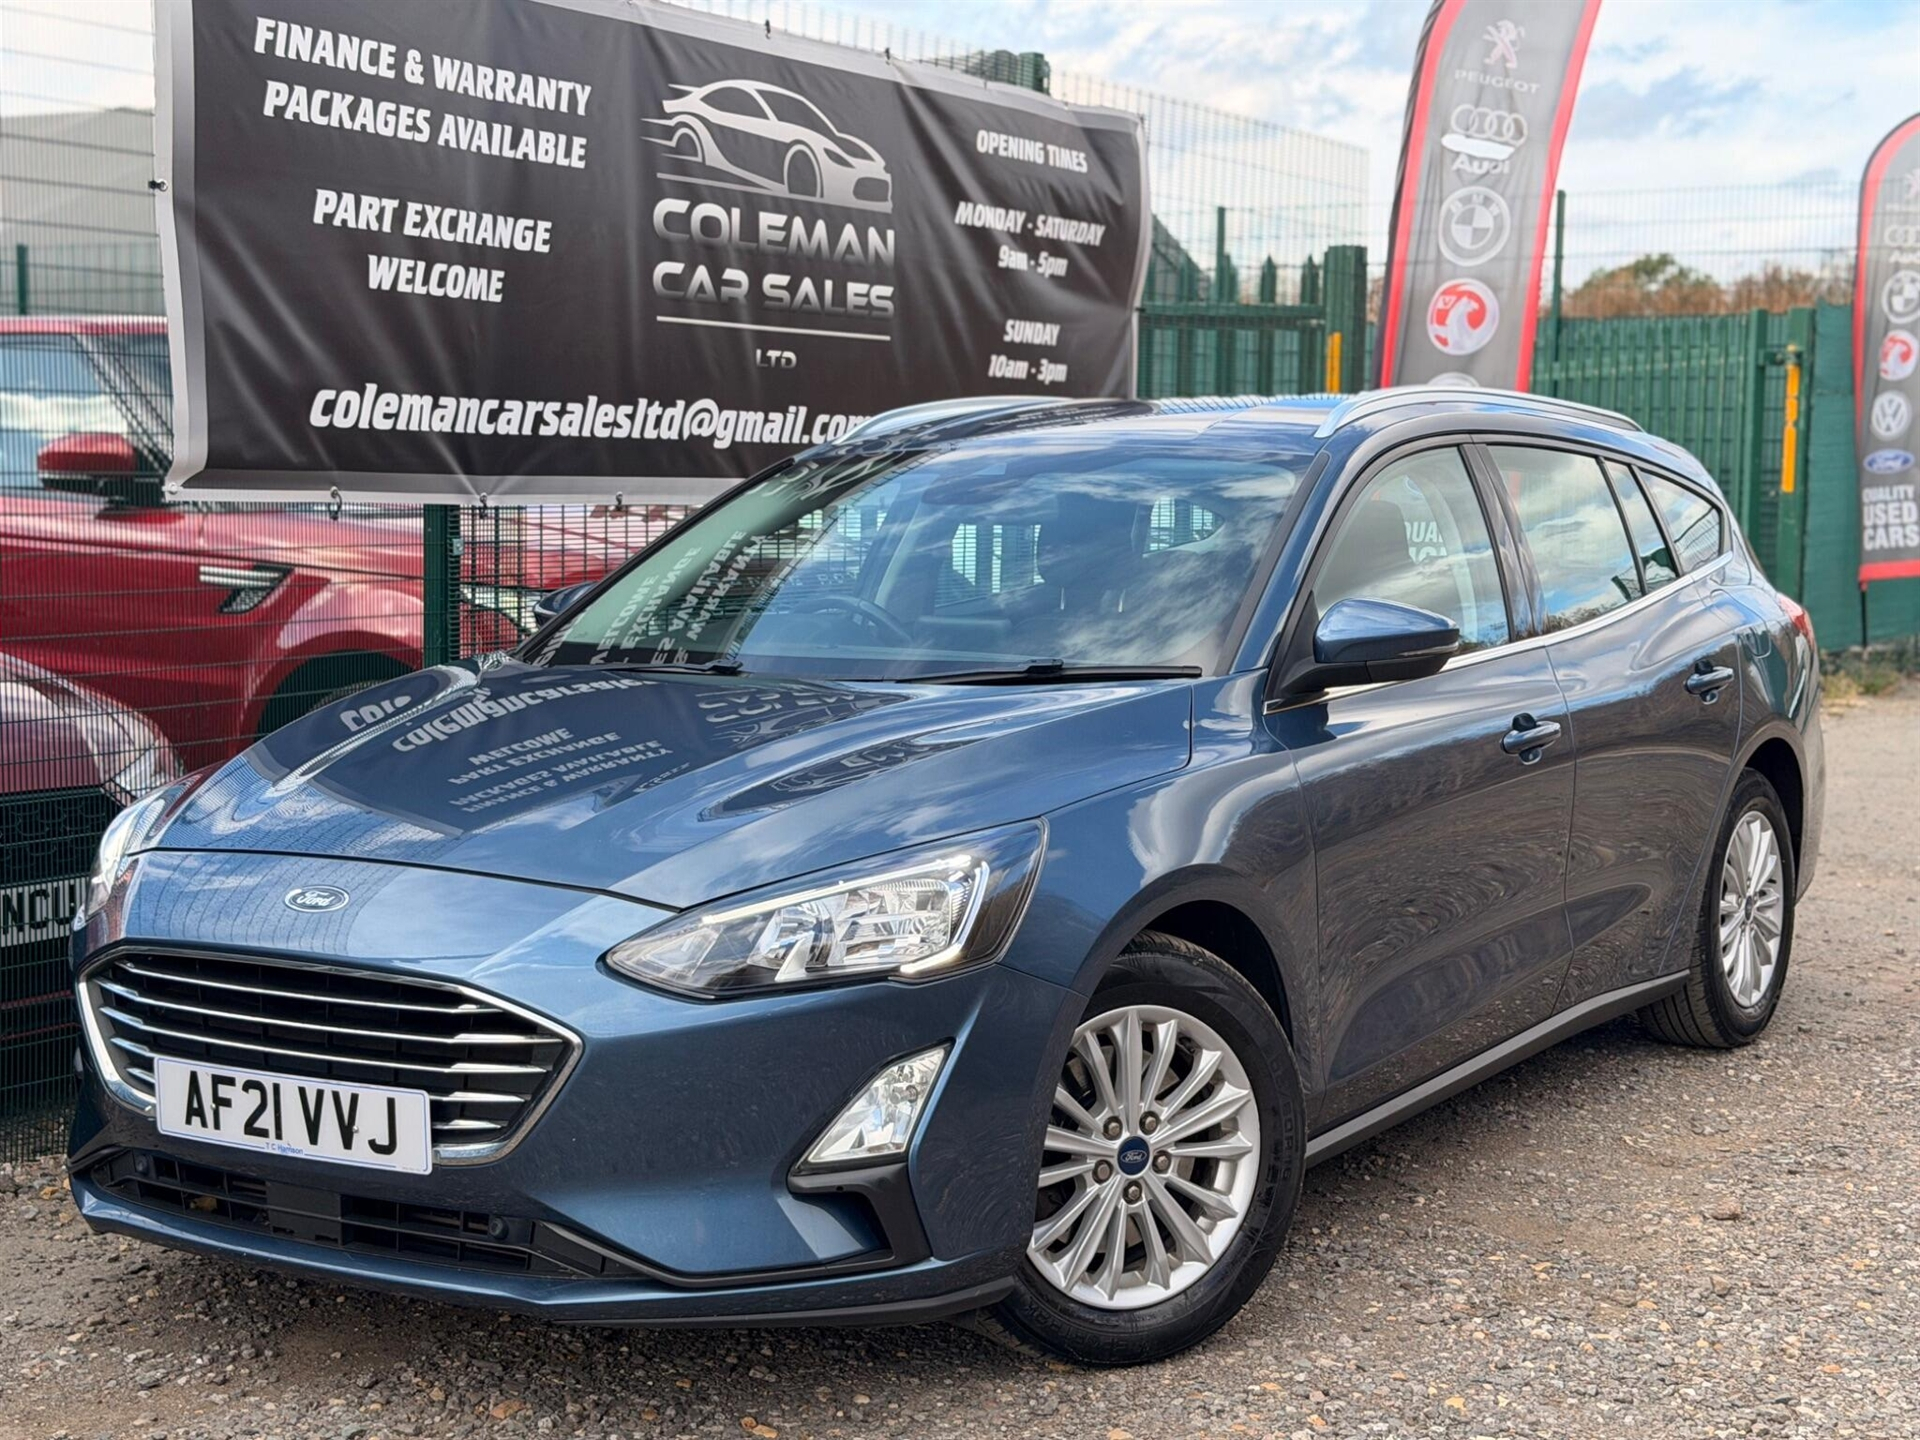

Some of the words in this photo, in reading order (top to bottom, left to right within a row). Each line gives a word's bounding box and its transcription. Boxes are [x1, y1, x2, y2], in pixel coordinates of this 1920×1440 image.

[254, 16, 397, 79] FINANCE
[404, 49, 424, 85] &
[432, 54, 591, 116] WARRANTY
[1454, 69, 1540, 94] PEUGEOT
[263, 80, 431, 143] PACKAGES
[437, 113, 587, 168] AVAILABLE
[976, 130, 1045, 164] OPENING
[1047, 145, 1088, 173] TIMES
[1452, 153, 1510, 174] Audi
[313, 189, 399, 233] PART
[403, 201, 552, 253] EXCHANGE
[653, 198, 894, 267] COLEMAN
[955, 201, 1026, 234] MONDAY
[1034, 214, 1106, 247] SATURDAY
[368, 254, 505, 302] WELCOME
[998, 245, 1028, 271] 9am
[1037, 251, 1068, 278] 5pm
[653, 261, 749, 303] CAR
[762, 273, 894, 319] SALES
[1003, 319, 1060, 346] SUNDAY
[756, 349, 797, 369] LTD
[988, 354, 1029, 379] 10am
[1037, 358, 1068, 384] 3pm
[1862, 485, 1915, 502] QUALITY
[1863, 501, 1918, 526] USED
[1863, 524, 1920, 551] CARS
[185, 1070, 283, 1141] AF21
[298, 1085, 398, 1155] VVJ
